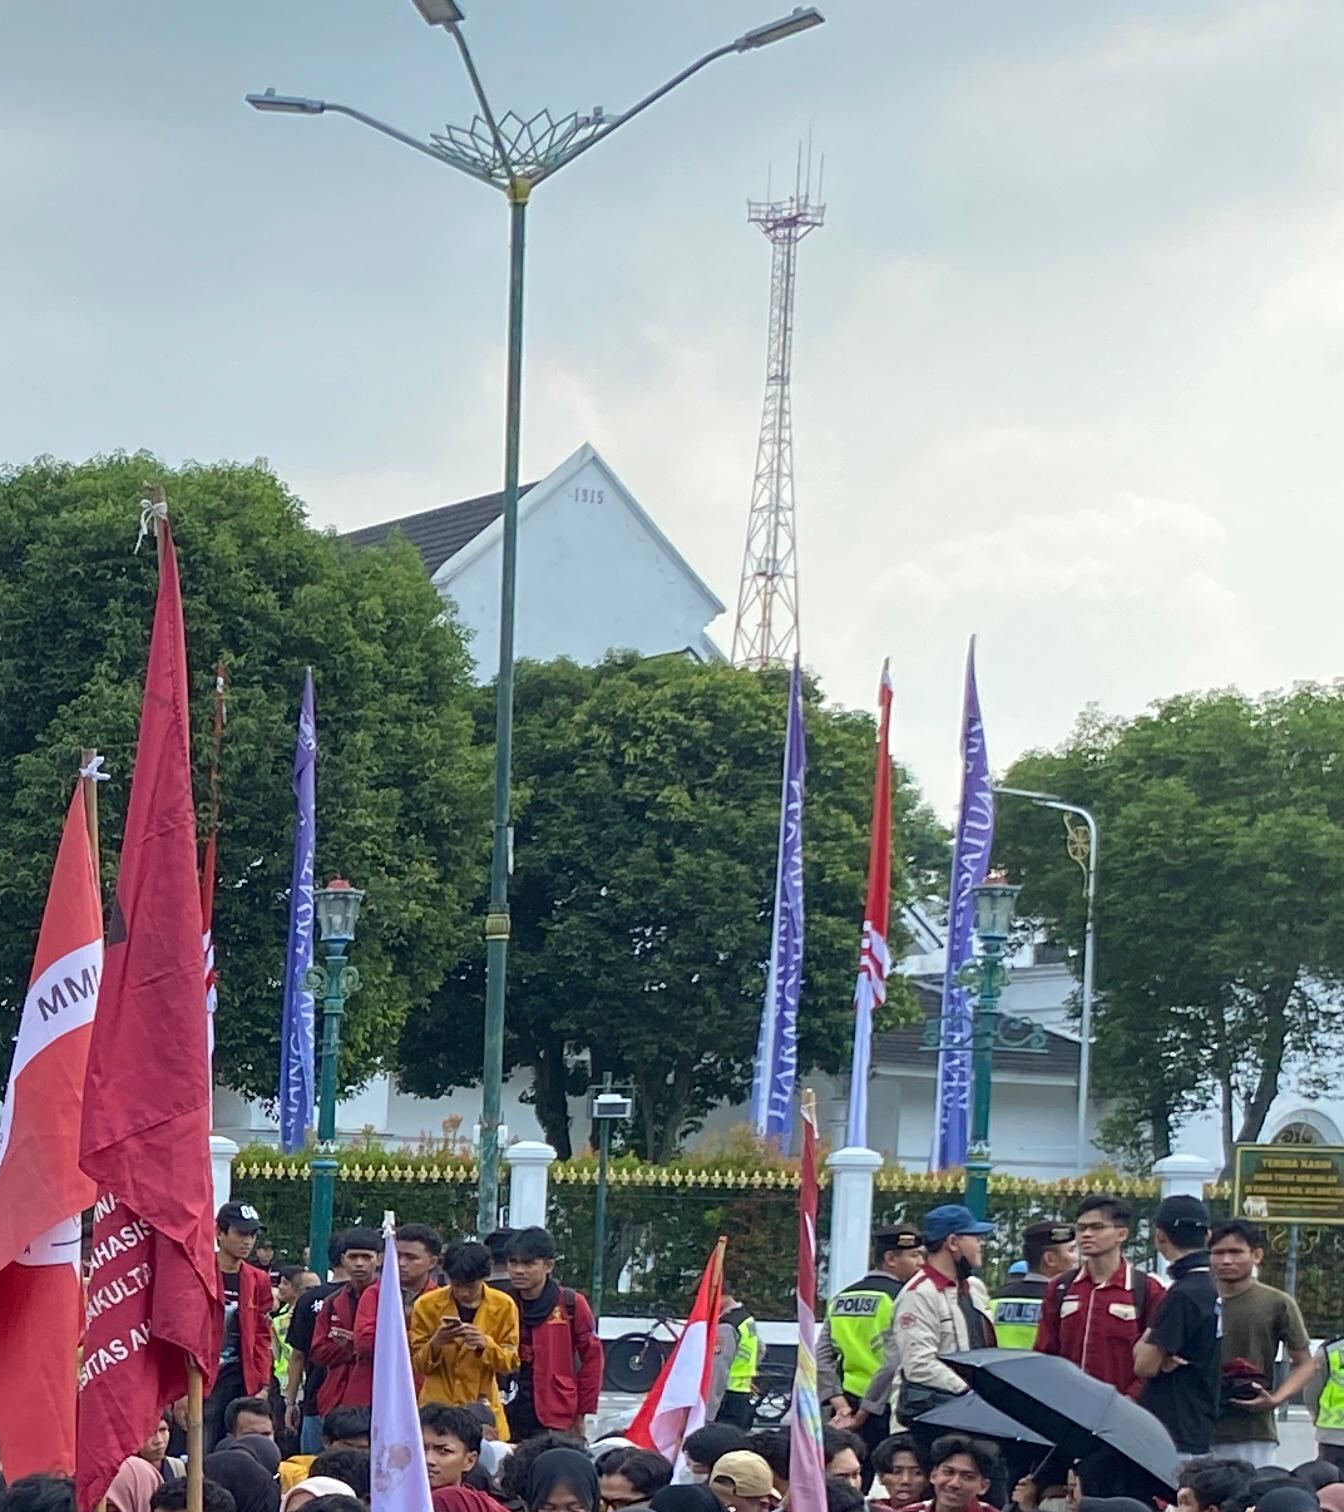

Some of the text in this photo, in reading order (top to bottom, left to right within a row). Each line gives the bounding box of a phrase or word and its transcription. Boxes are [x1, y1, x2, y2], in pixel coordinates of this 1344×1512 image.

[37, 964, 100, 1022] MM
[835, 1296, 878, 1312] POLISI
[996, 1303, 1042, 1321] POLISI
